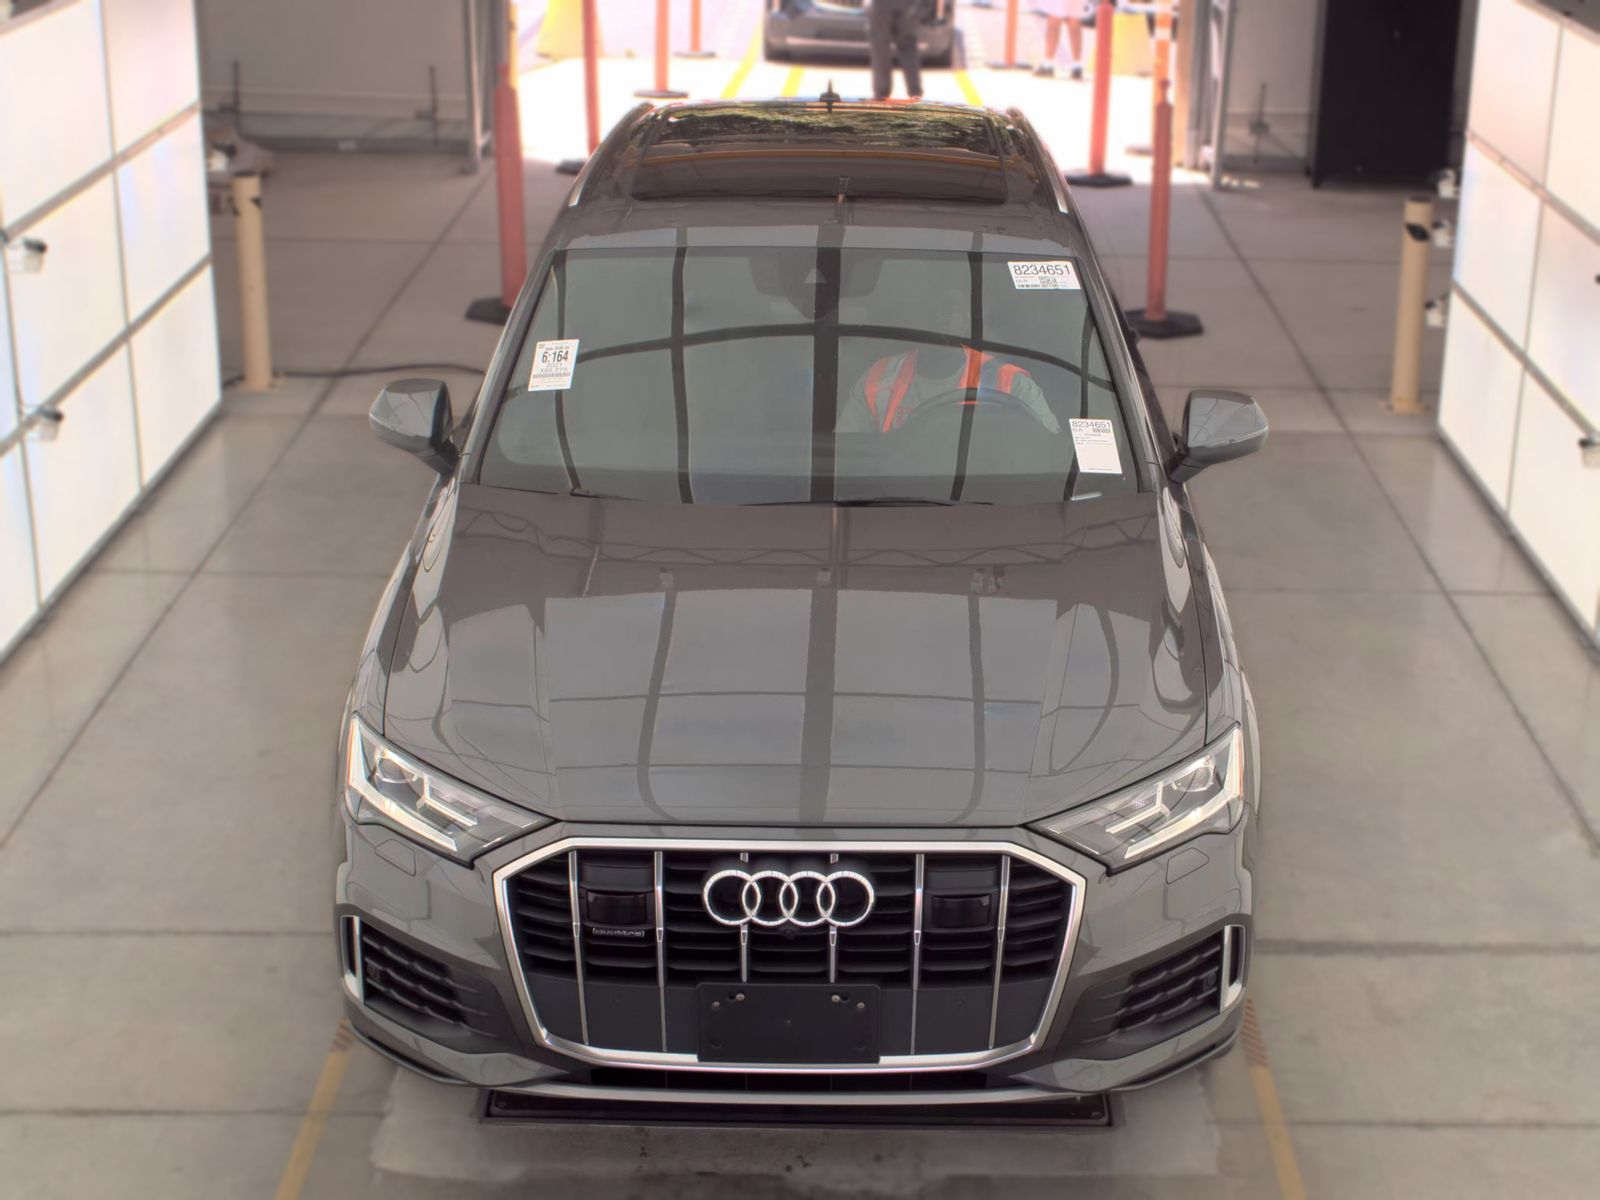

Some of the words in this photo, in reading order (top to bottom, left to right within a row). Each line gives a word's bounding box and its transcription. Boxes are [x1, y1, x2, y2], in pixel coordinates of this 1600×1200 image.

[1013, 264, 1071, 276] 8234651
[541, 350, 569, 363] 6:164
[1072, 420, 1111, 429] 8234651
